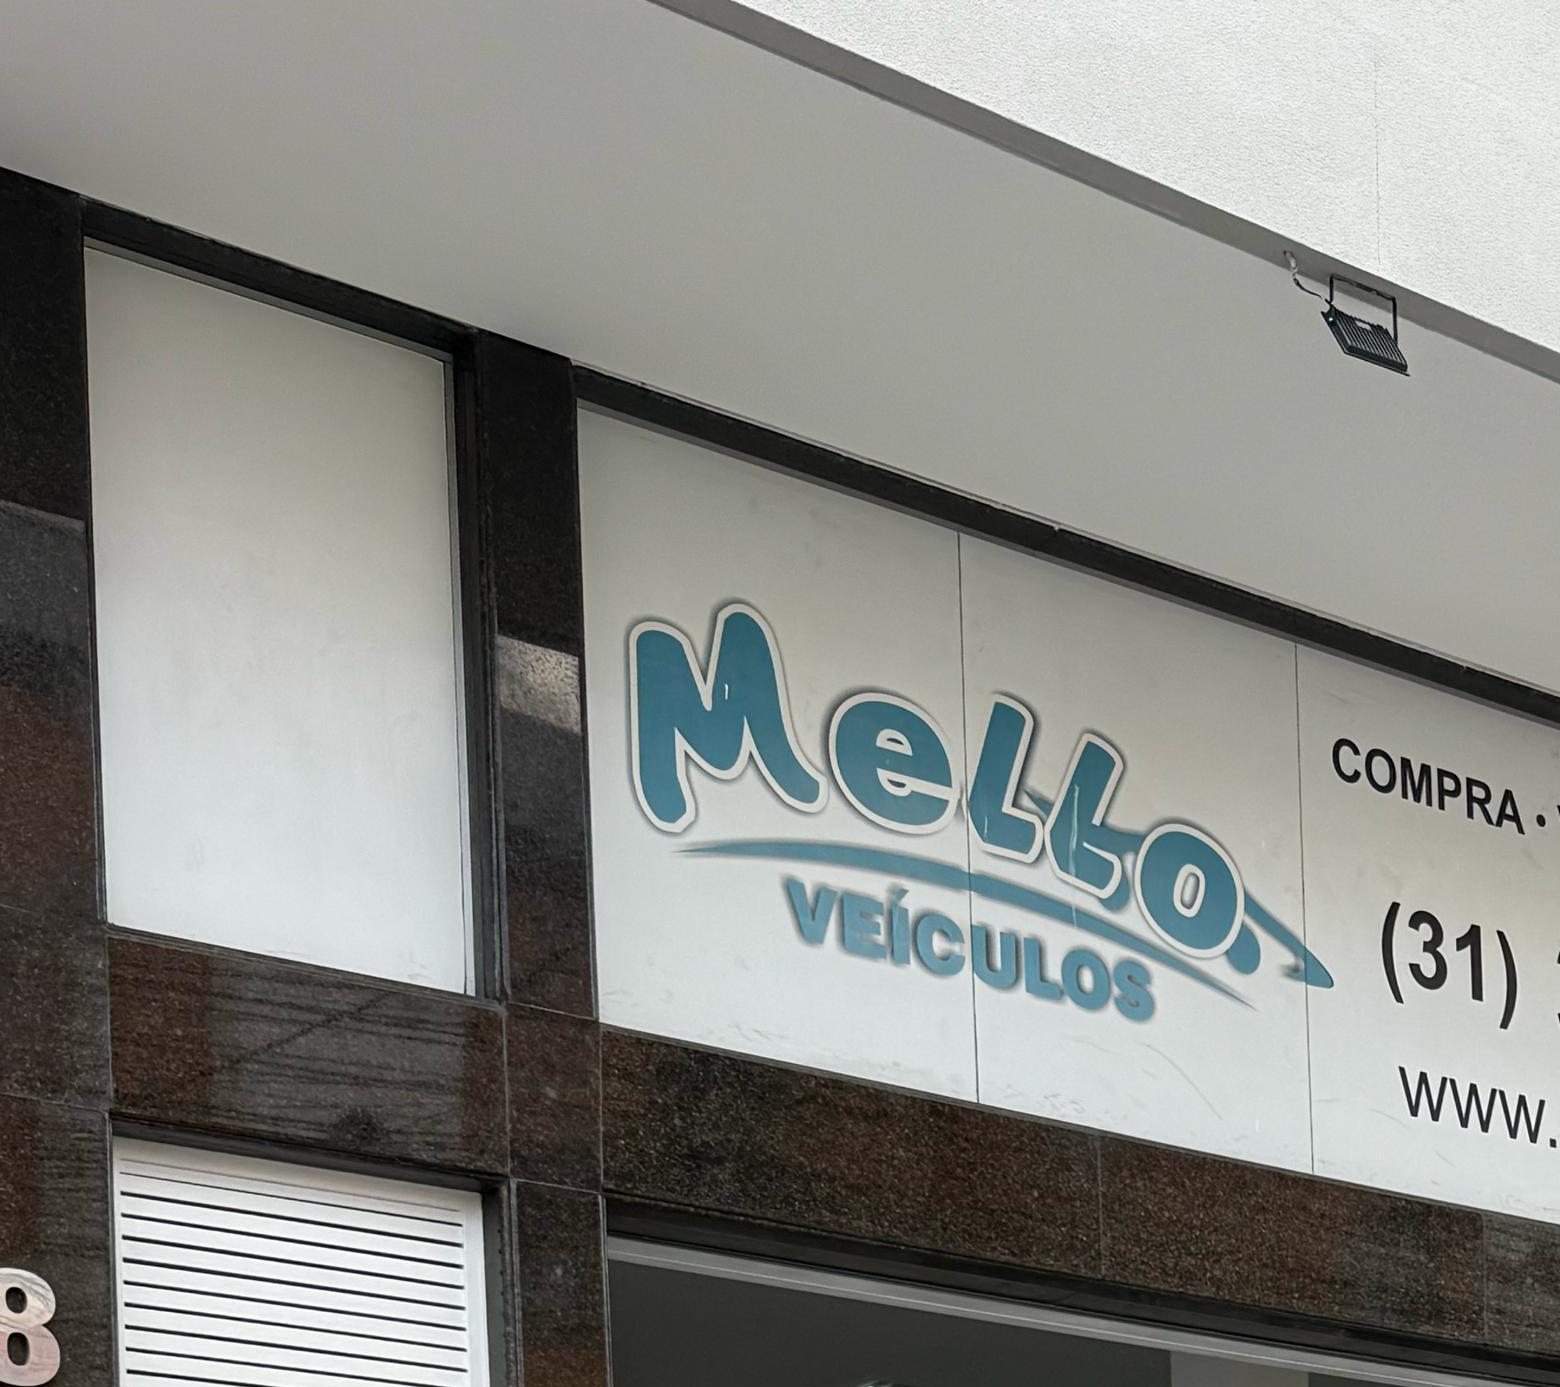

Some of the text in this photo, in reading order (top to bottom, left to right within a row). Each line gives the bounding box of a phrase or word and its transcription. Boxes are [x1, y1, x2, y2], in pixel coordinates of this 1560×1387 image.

[1331, 737, 1525, 835] COMPRA
[781, 876, 1156, 1023] VEÍCULOS
[1381, 901, 1518, 1030] (31)
